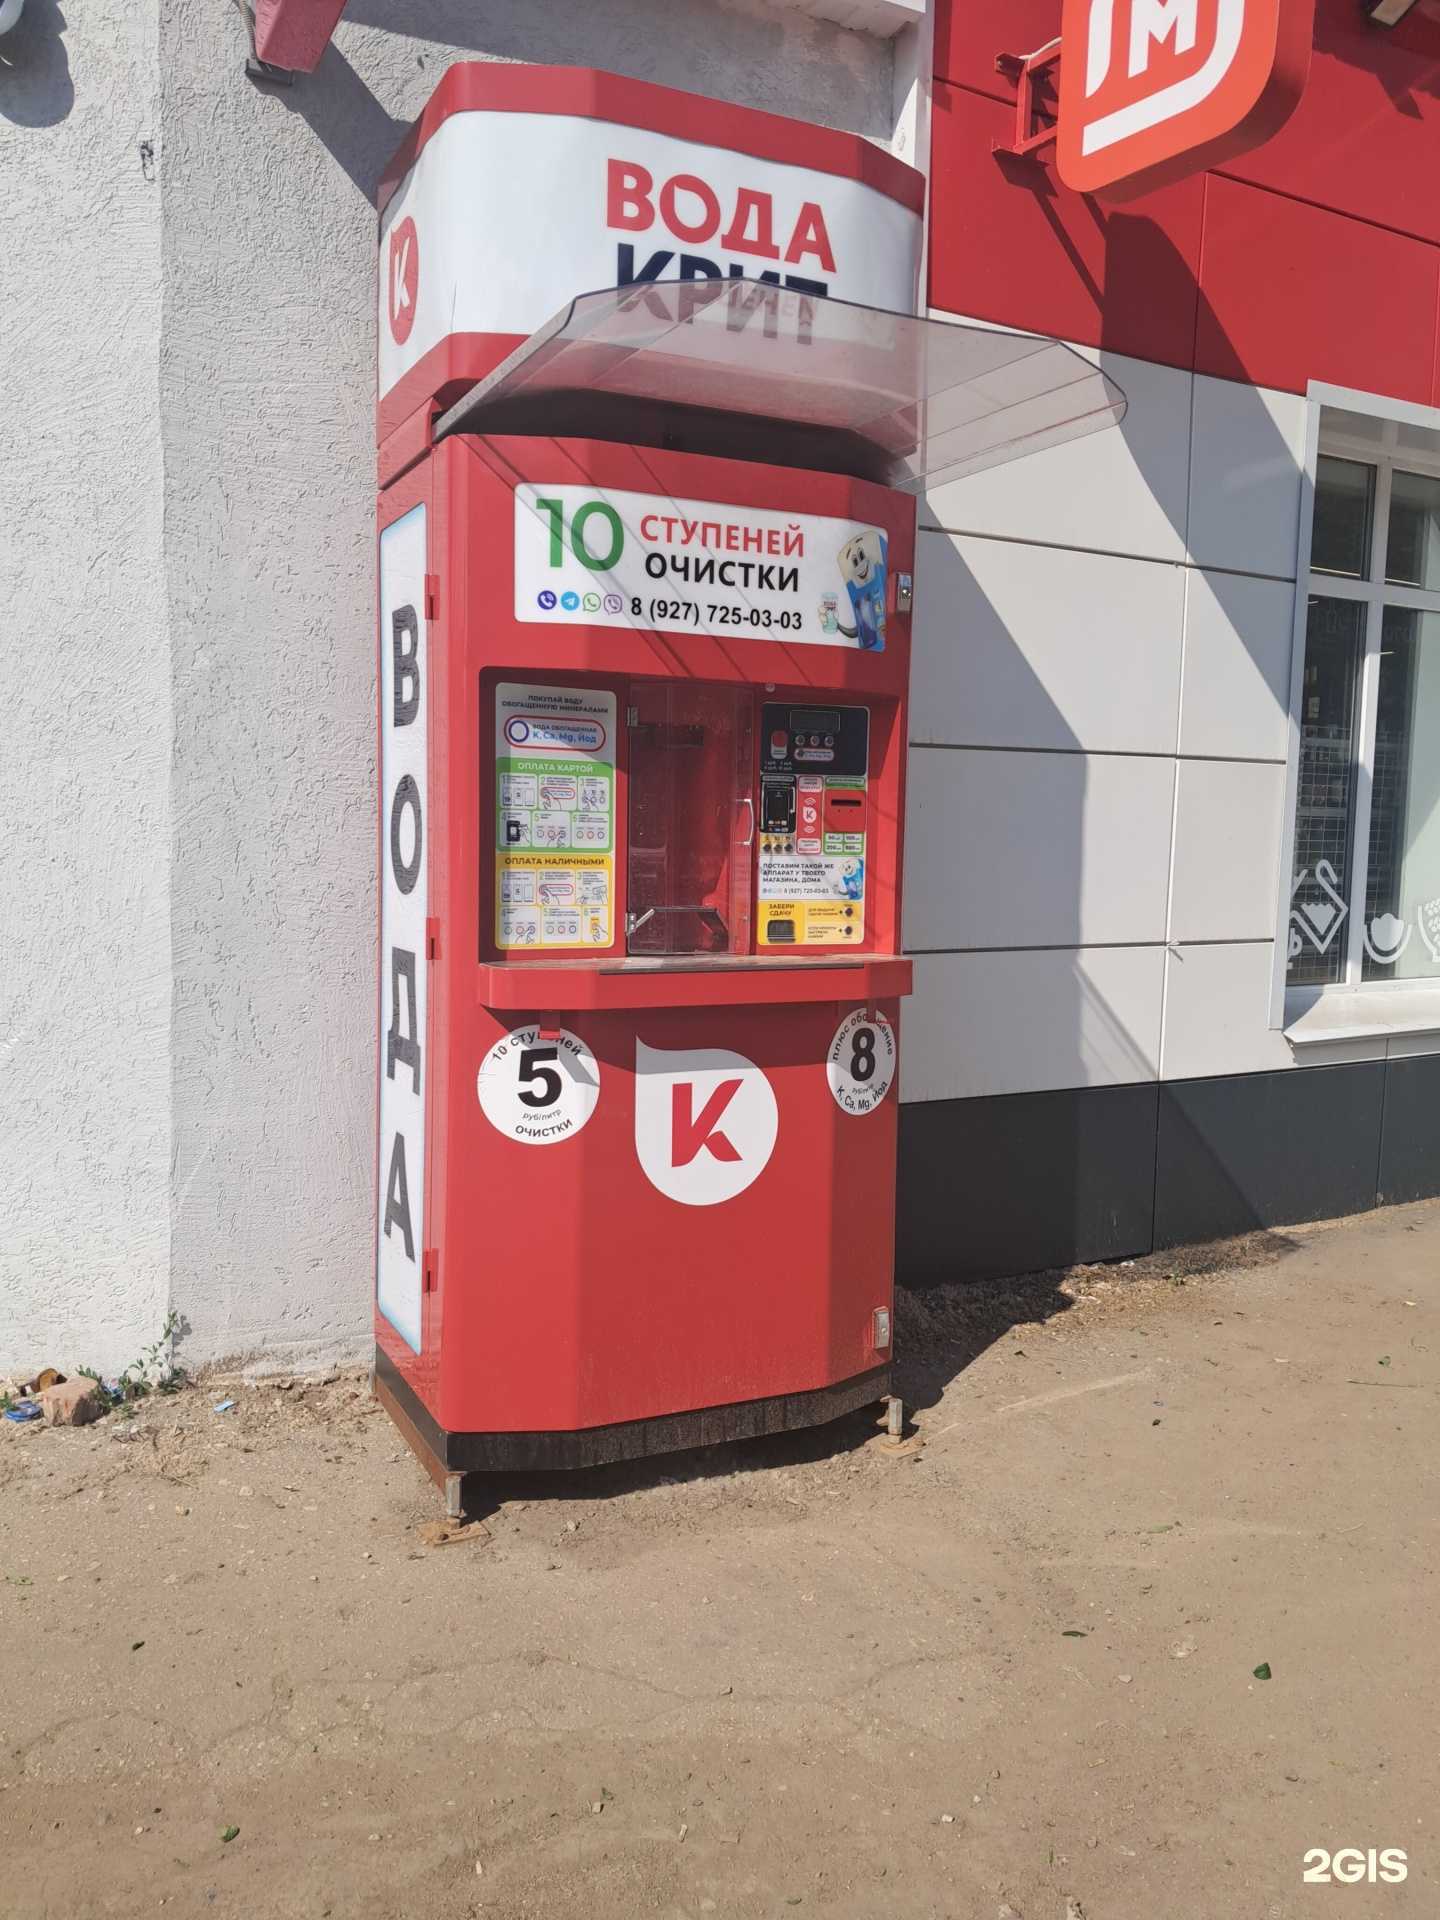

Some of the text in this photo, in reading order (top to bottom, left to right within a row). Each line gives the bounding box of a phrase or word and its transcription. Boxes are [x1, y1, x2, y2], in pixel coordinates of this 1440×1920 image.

[606, 158, 837, 273] ВОДА
[617, 243, 828, 345] КРИТ
[536, 498, 625, 572] 10
[639, 514, 804, 557] СТУПЕНЕЙ
[644, 552, 799, 592] ОЧИСТКИ
[631, 597, 802, 630] 8 (927) 725-03-03
[518, 762, 593, 773] ОПЛАТА КАРТОЙ
[505, 857, 542, 865] ОПЛАТА
[493, 1030, 584, 1060] 10 стуней
[833, 1025, 850, 1060] плюс
[850, 1027, 876, 1081] 8
[517, 1047, 562, 1107] 5
[515, 1118, 573, 1137] ОЧИСТКИ
